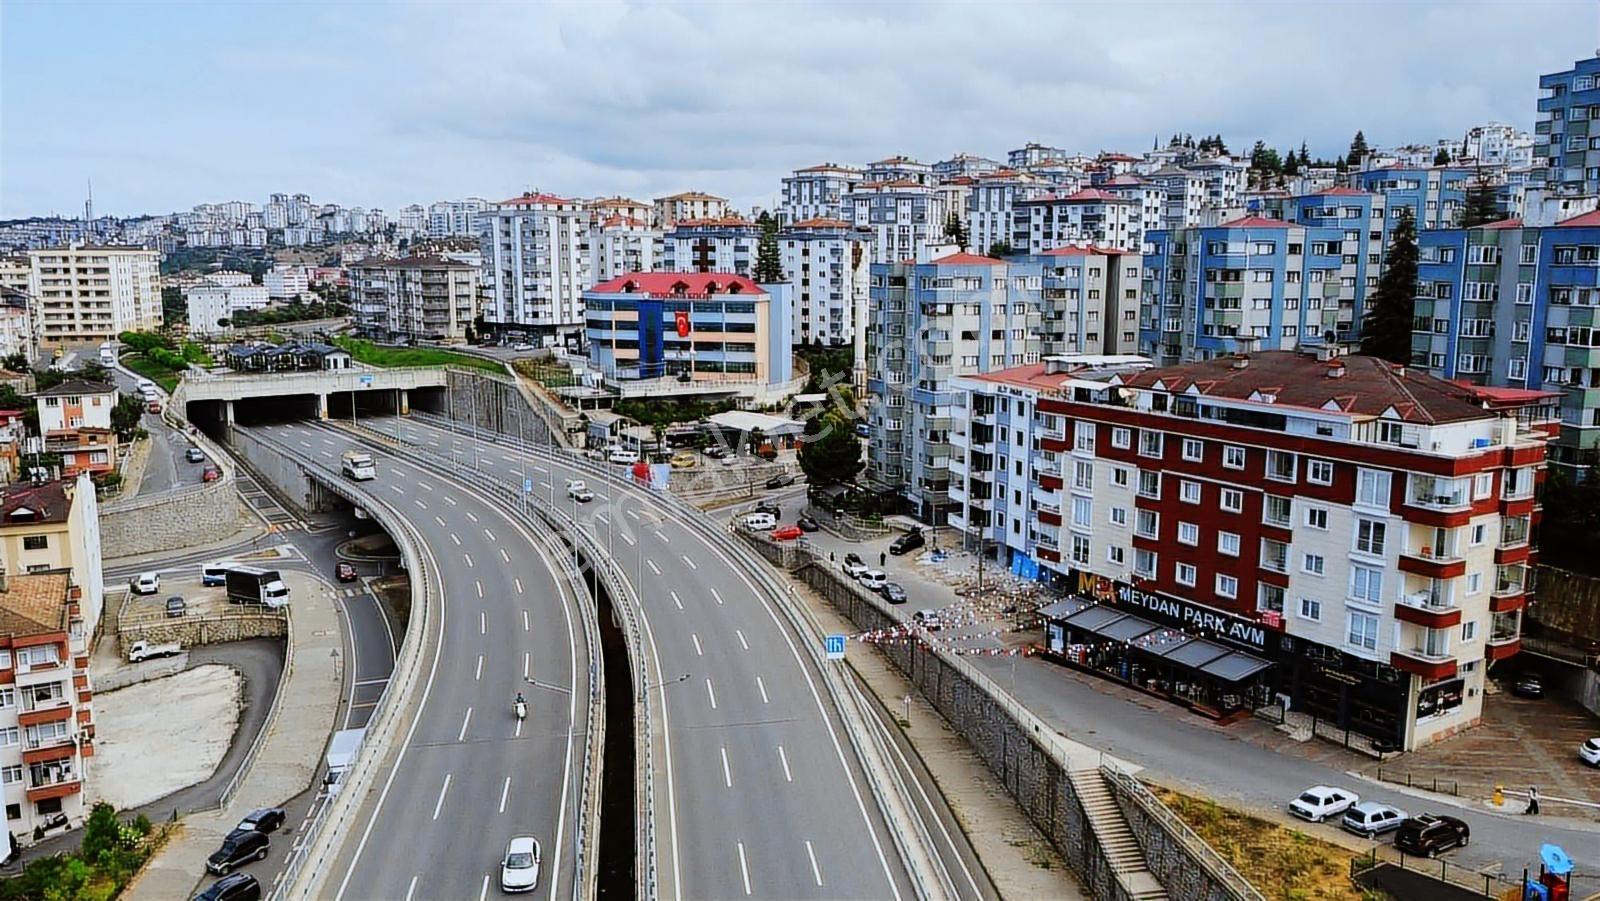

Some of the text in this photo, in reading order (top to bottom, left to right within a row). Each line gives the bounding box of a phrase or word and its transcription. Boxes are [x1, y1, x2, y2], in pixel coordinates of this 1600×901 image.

[1119, 586, 1265, 646] MEYDAN PARK AVM
